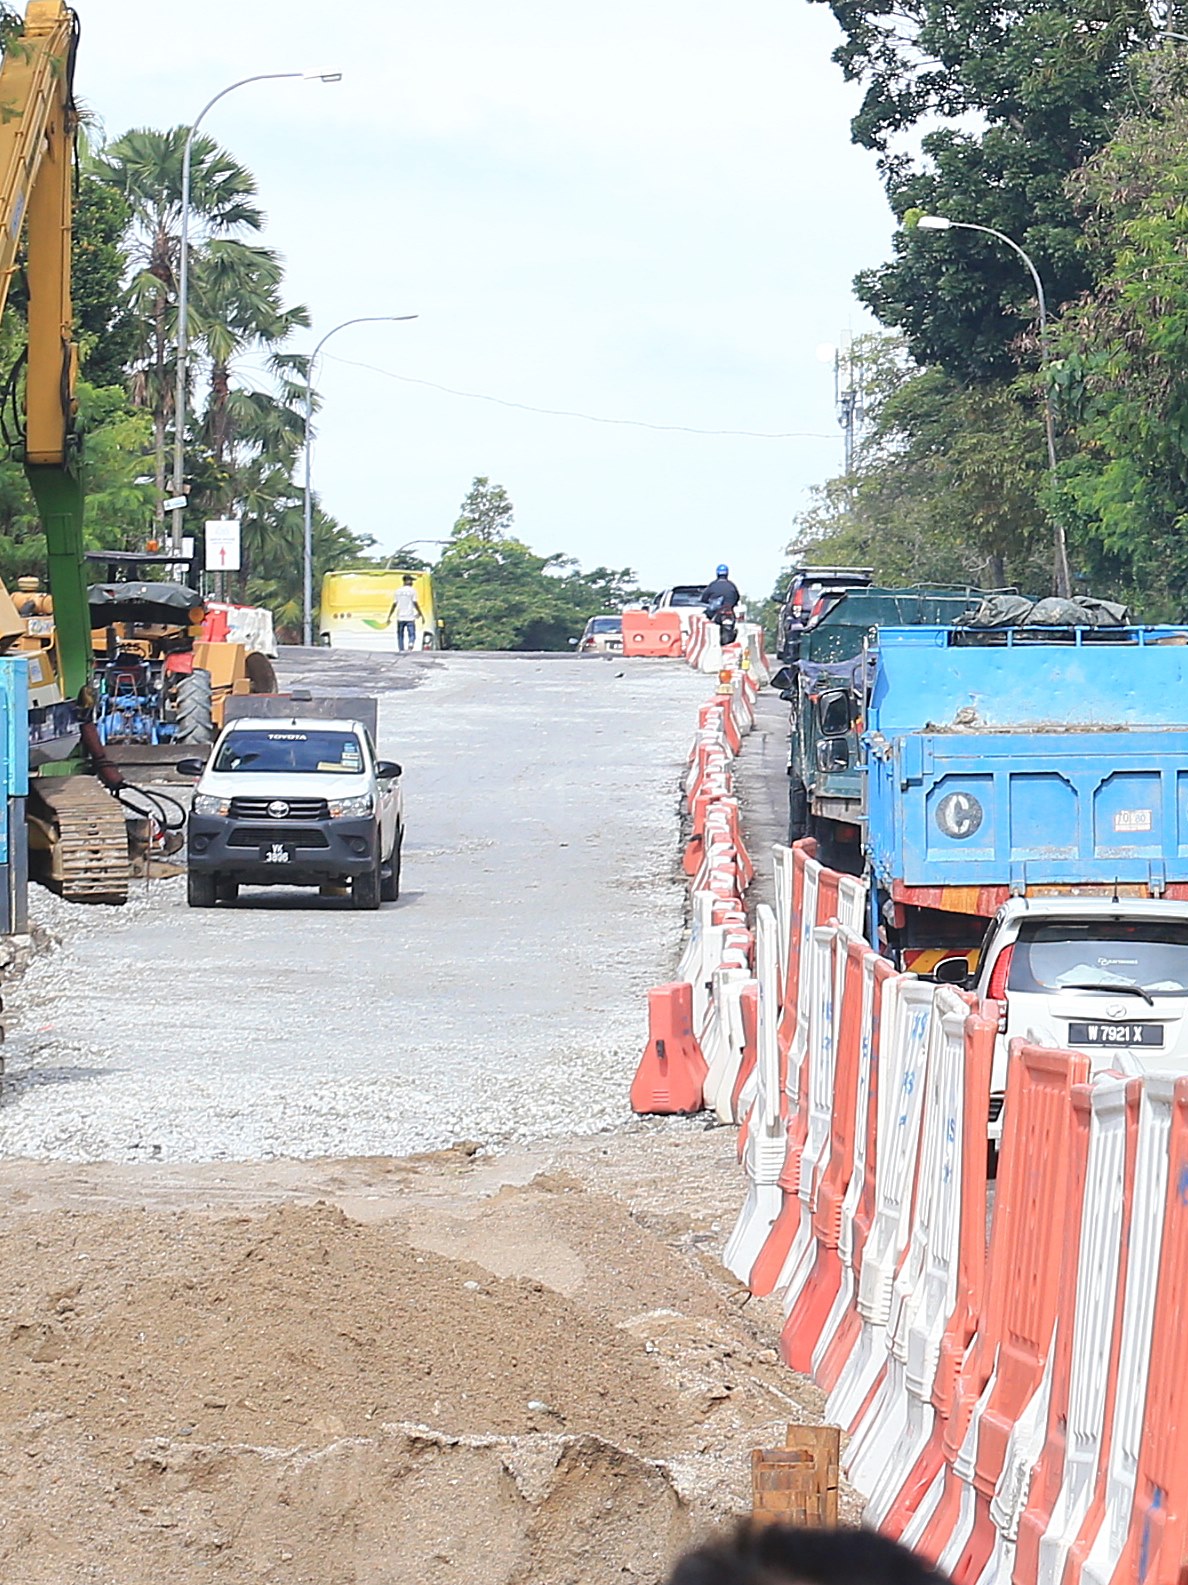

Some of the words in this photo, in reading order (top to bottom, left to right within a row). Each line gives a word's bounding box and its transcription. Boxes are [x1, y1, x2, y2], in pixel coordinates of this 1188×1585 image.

[267, 733, 307, 741] TOYOTA
[945, 795, 970, 834] C
[1087, 1024, 1099, 1041] W
[1101, 1025, 1130, 1041] 7921
[1133, 1025, 1143, 1042] X
